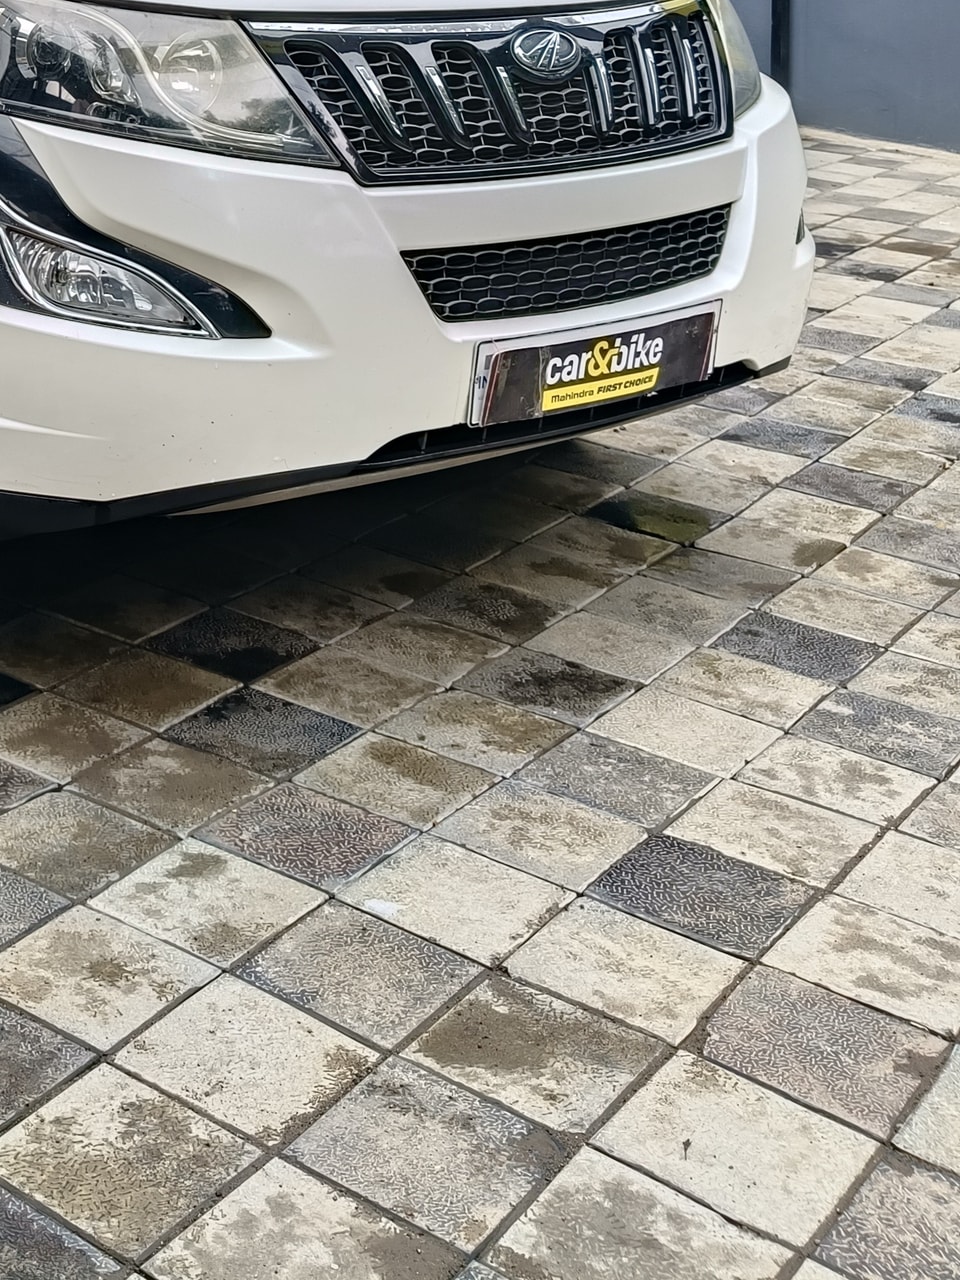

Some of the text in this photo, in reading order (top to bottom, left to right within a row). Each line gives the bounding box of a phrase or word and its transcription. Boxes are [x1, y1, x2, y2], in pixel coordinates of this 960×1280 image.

[545, 332, 664, 386] car&bike
[551, 374, 654, 404] Mahindra FIRST CHOICE
